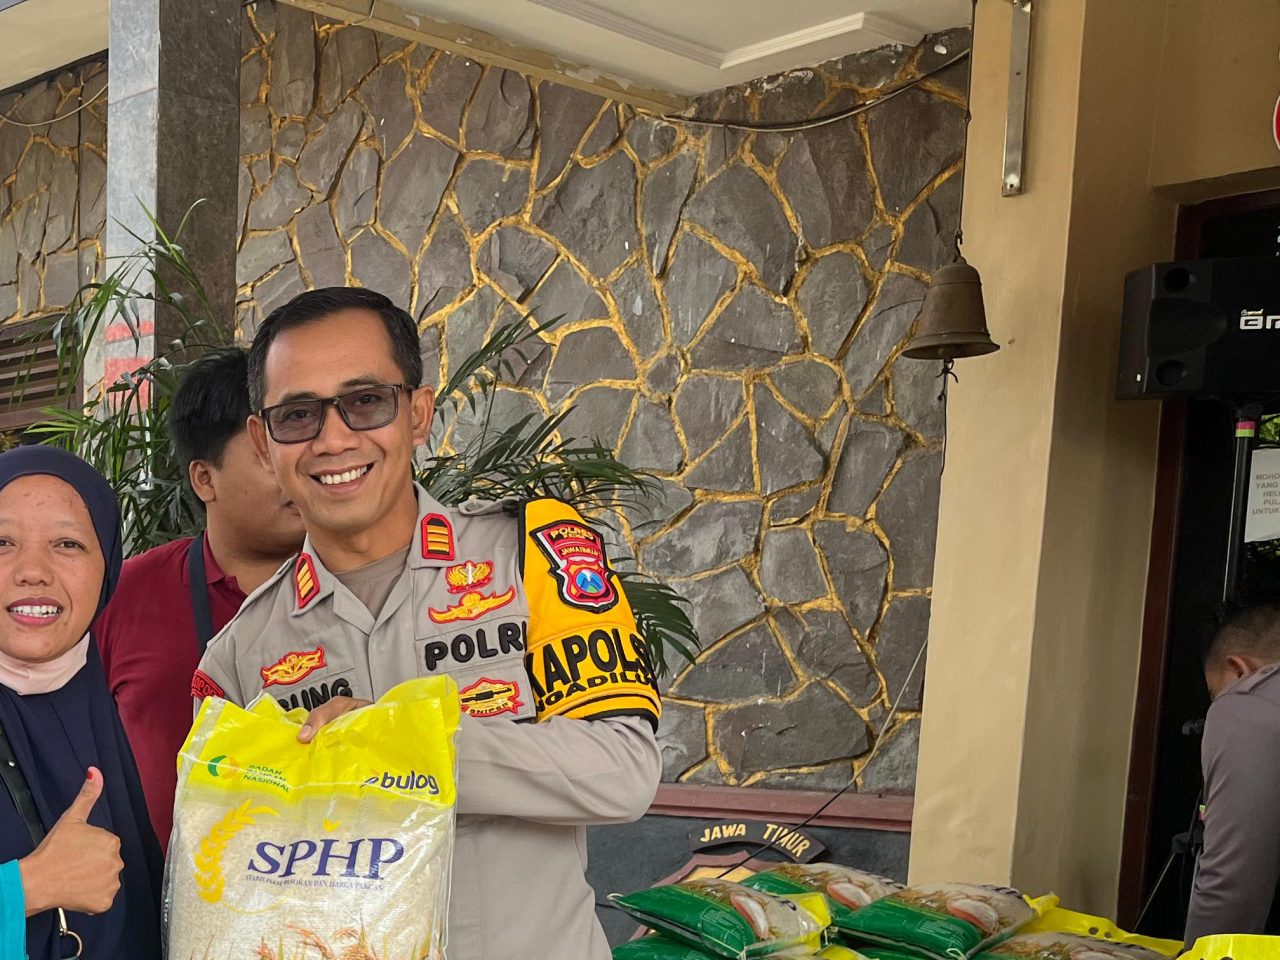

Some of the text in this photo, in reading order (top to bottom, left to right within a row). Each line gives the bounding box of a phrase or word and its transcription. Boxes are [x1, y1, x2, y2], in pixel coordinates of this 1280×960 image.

[425, 620, 527, 671] POLRI
[244, 774, 289, 792] NASIONAL
[380, 770, 439, 794] bulog
[700, 823, 811, 857] JAWA TIMUR
[247, 838, 404, 880] SPHP
